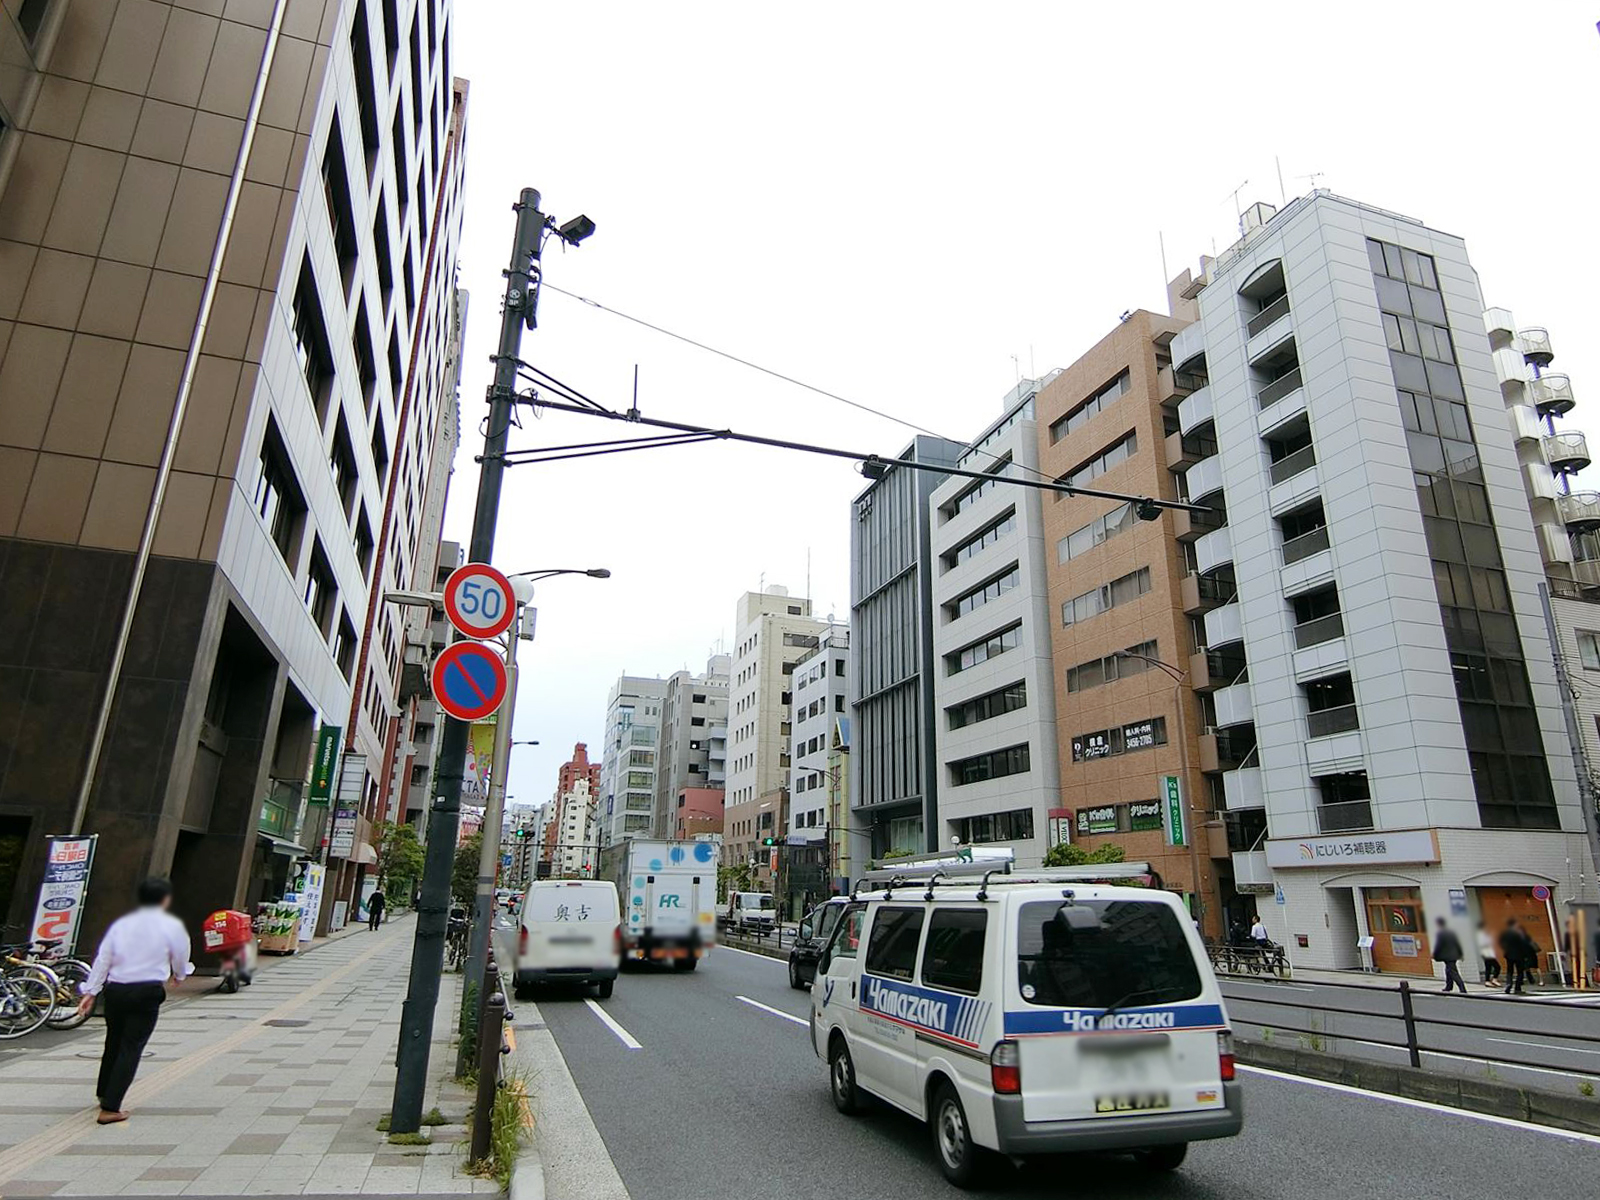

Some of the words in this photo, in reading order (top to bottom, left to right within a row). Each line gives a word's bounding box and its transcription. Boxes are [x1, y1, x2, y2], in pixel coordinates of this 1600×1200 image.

[461, 581, 500, 619] 50
[1085, 744, 1109, 757] クリニック
[1130, 803, 1159, 817] クリニック
[1316, 841, 1386, 857] にじいろ補聴器
[554, 904, 591, 922] 奥吉
